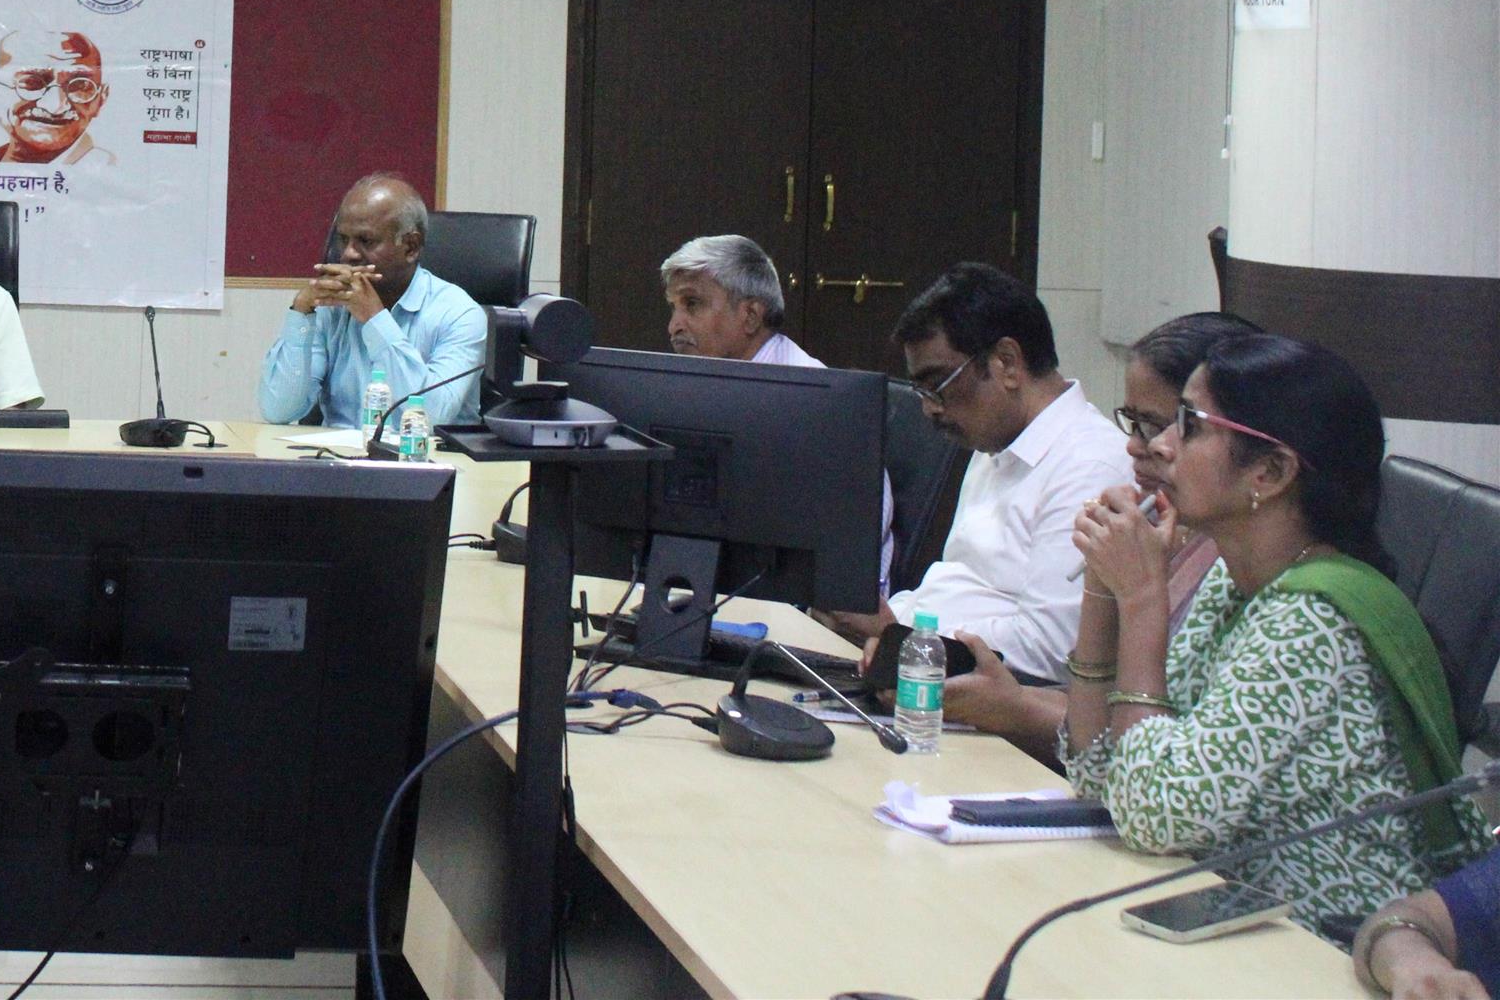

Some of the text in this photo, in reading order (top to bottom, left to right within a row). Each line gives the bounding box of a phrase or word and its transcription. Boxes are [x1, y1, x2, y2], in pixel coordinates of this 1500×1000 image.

[140, 48, 193, 63] राष्ट्रभाषा
[145, 66, 193, 80] के बिना
[143, 88, 192, 103] एक राष्ट्र
